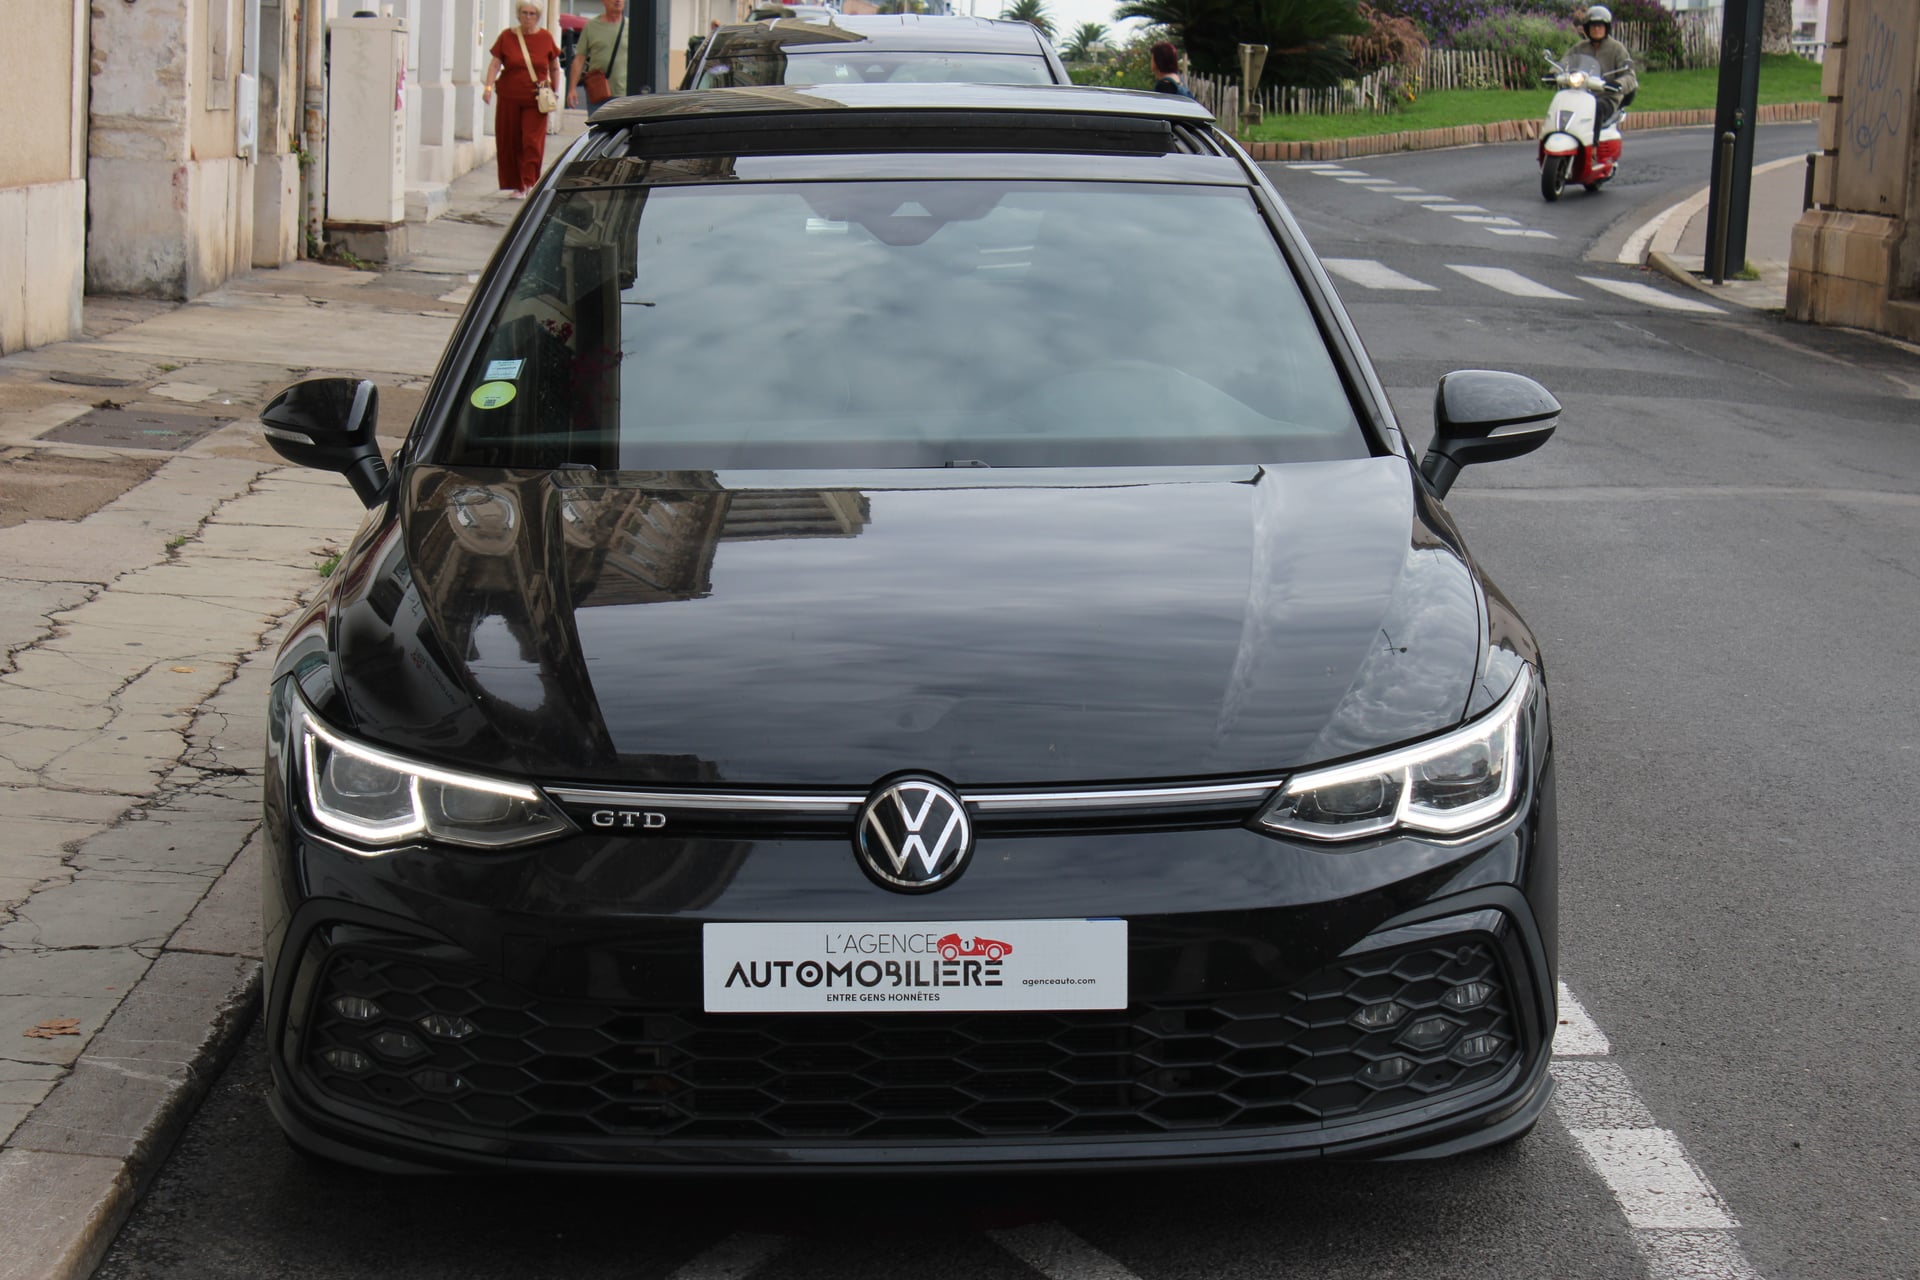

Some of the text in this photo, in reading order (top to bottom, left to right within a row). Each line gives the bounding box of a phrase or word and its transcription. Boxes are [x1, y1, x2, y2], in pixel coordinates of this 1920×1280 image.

[591, 810, 666, 828] GTD
[826, 933, 938, 954] L'AGENCE
[1022, 977, 1096, 987] agenceauto.com
[826, 991, 940, 1002] ENTRE GENS HONNÊTES
